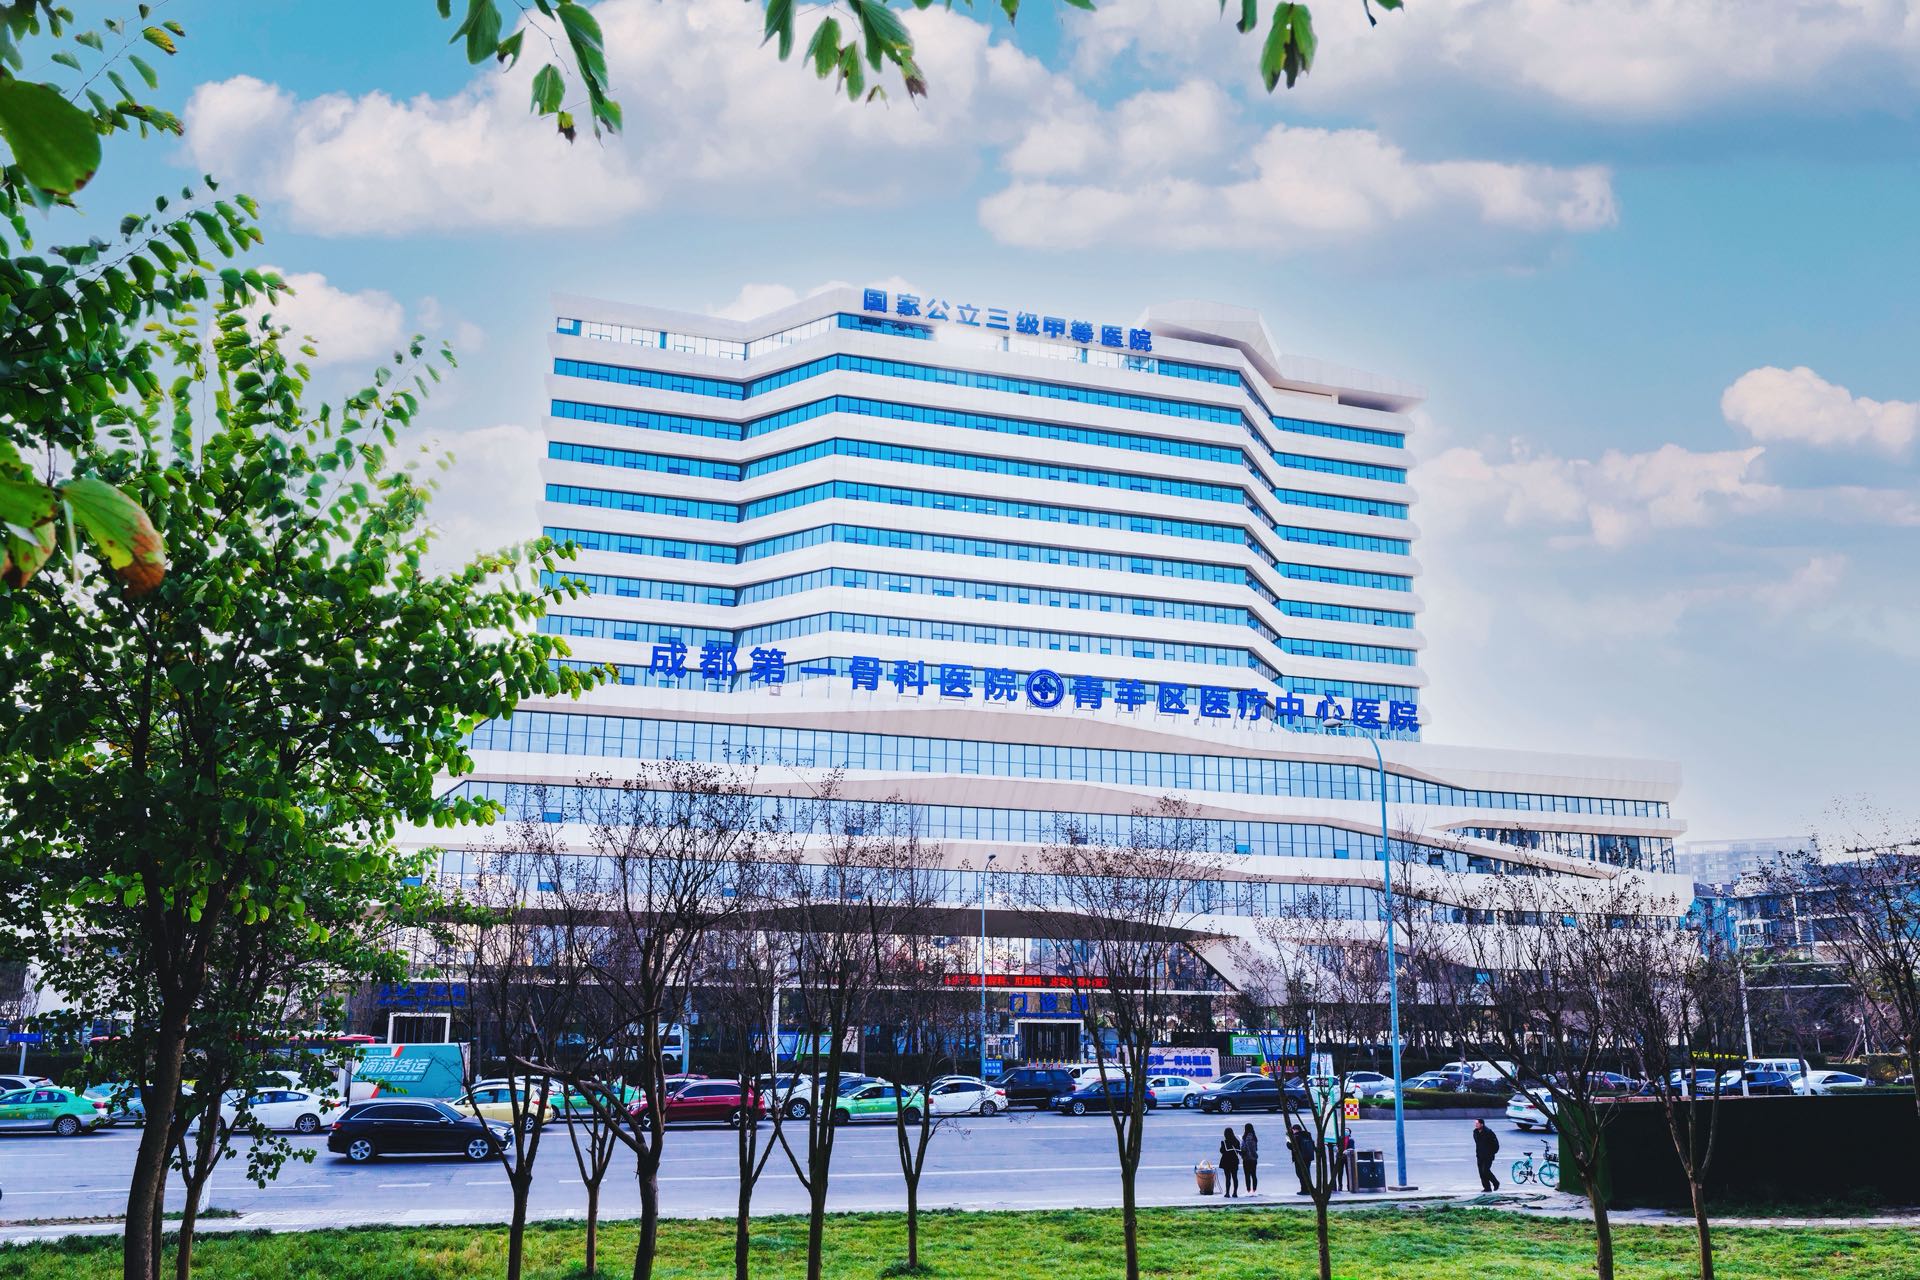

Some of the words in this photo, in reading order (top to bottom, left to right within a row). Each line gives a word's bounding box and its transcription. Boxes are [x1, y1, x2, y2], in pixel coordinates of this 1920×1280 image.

[864, 287, 1152, 352] 国家公立三级甲等医院
[649, 642, 1018, 702] 成都第一骨科医院
[1072, 675, 1420, 732] 青羊区医疗中心医院
[360, 1057, 430, 1073] 滴滴货运
